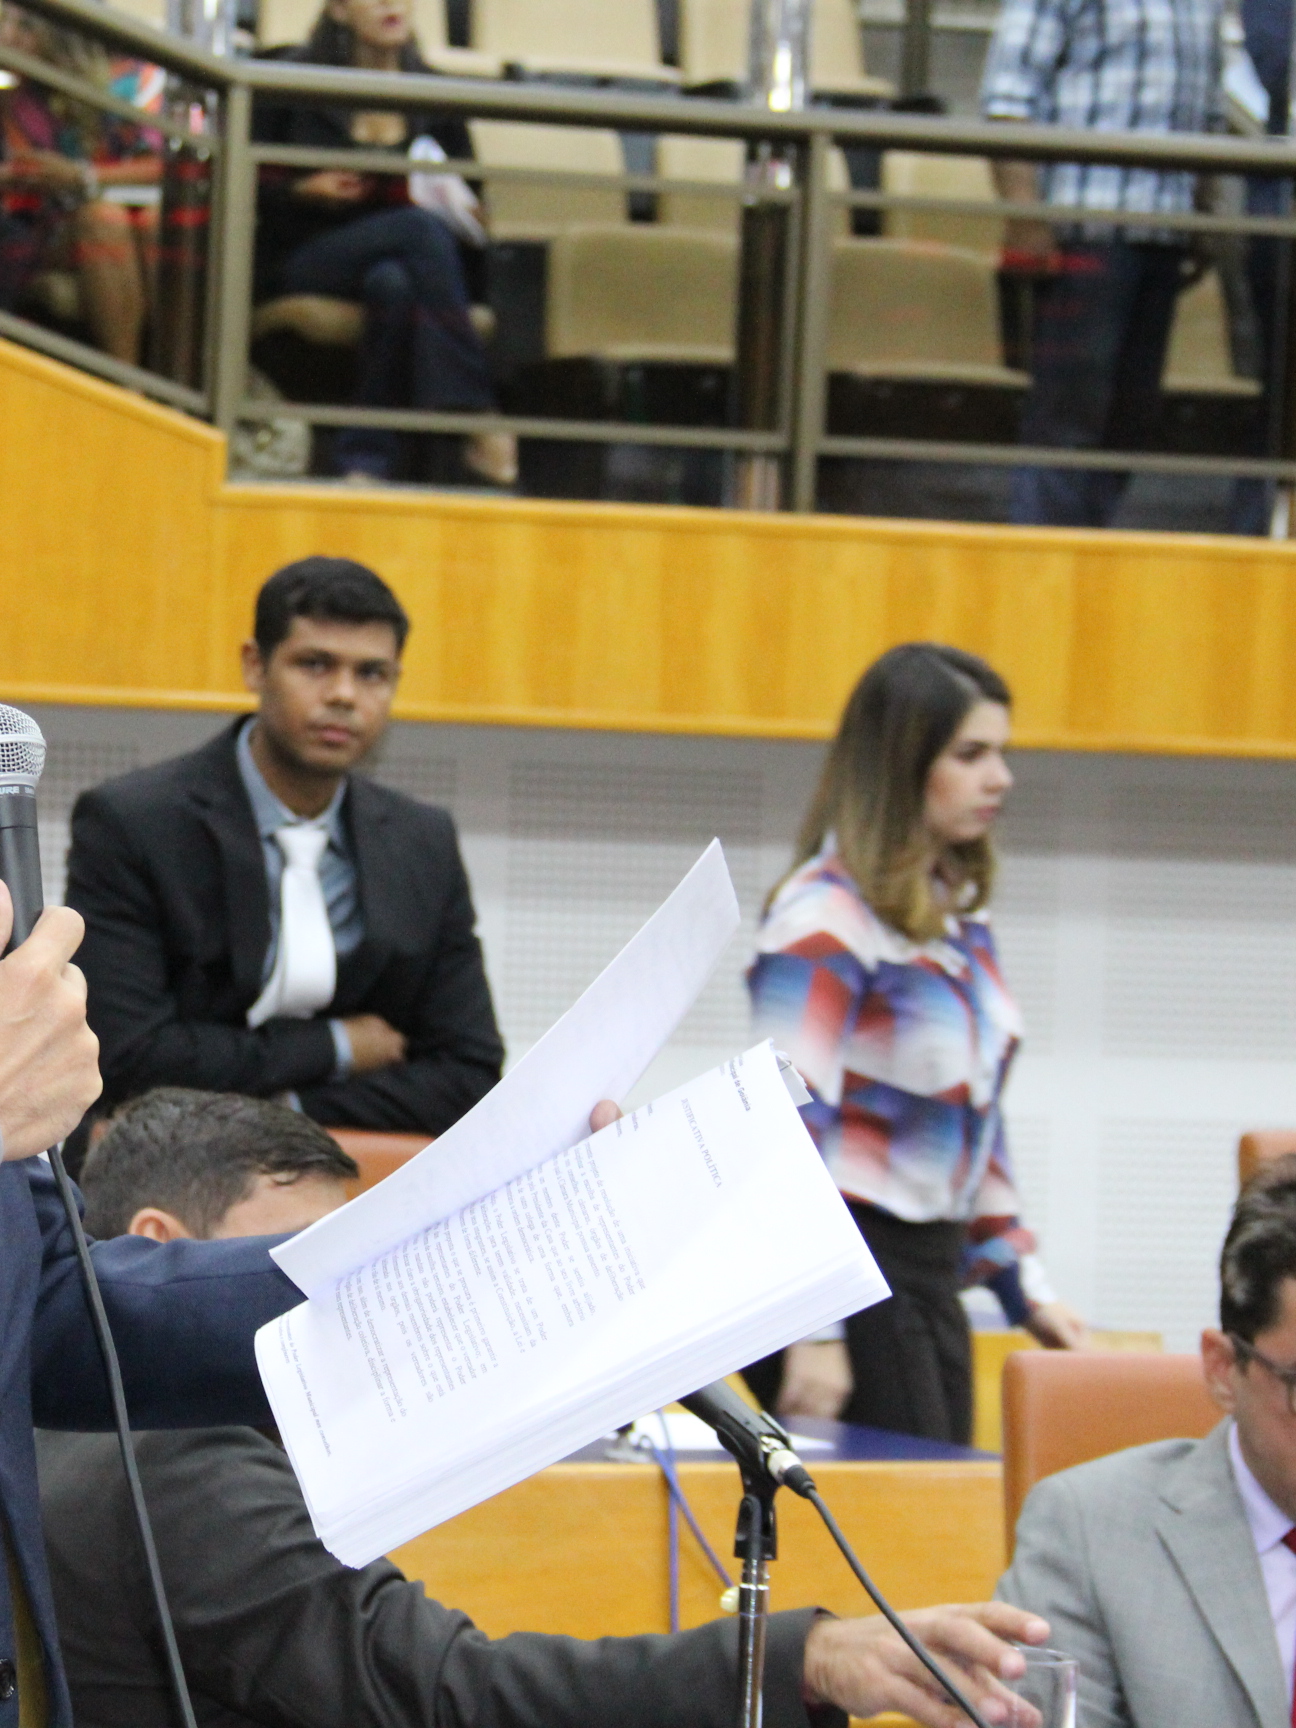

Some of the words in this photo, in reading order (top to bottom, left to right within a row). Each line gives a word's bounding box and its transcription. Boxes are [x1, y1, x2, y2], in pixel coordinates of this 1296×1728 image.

[681, 1098, 705, 1149] JUSTIFICATIVA
[701, 1149, 722, 1188] POLÍTICA
[737, 1087, 751, 1111] Goiânia
[468, 1250, 481, 1276] diferente.
[511, 1209, 521, 1226] ordem
[517, 1226, 534, 1264] democrática.
[525, 1213, 535, 1231] colega
[532, 1233, 539, 1241] de
[537, 1246, 546, 1259] uma
[544, 1261, 555, 1282] forma
[553, 1285, 562, 1300] que,
[561, 1303, 574, 1327] embora
[540, 1220, 547, 1228] da
[544, 1228, 553, 1244] Casa
[549, 1246, 559, 1257] que
[556, 1259, 563, 1267] ao
[560, 1268, 568, 1280] seu
[565, 1280, 575, 1296] livre
[572, 1298, 585, 1321] arbítrio
[550, 1212, 560, 1228] deste
[558, 1231, 570, 1250] Poder
[568, 1255, 574, 1263] se
[573, 1267, 584, 1287] sentiu
[583, 1291, 595, 1315] alijado,
[559, 1179, 569, 1200] Câmara
[566, 1199, 581, 1230] Municipal
[576, 1230, 589, 1253] possua
[586, 1254, 600, 1277] assento.
[577, 1198, 591, 1225] câmaras,
[589, 1228, 601, 1249] órgãos
[600, 1253, 607, 1261] de
[605, 1265, 623, 1301] deliberação
[583, 1179, 595, 1200] escolha
[592, 1204, 599, 1212] de
[598, 1215, 619, 1260] representantes
[618, 1264, 625, 1272] do
[623, 1275, 635, 1295] Poder
[596, 1179, 603, 1187] de
[601, 1188, 615, 1217] resolução
[617, 1232, 626, 1244] uma
[624, 1246, 640, 1276] iniciativa
[636, 1278, 646, 1290] que
[448, 1282, 455, 1291] do
[453, 1294, 464, 1314] Poder
[462, 1318, 481, 1358] Legislativo;
[480, 1363, 487, 1373] em
[452, 1257, 460, 1268] que
[458, 1276, 471, 1300] procura
[469, 1307, 485, 1335] primeiro
[481, 1338, 496, 1361] garantir
[486, 1265, 496, 1282] assim
[495, 1287, 515, 1331] Constituição,
[515, 1335, 523, 1347] Lei
[488, 1234, 497, 1248] para
[494, 1249, 504, 1267] terem
[502, 1269, 516, 1298] validade,
[514, 1301, 532, 1336] necessitam
[529, 1339, 536, 1348] da
[500, 1230, 516, 1264] Legislativo
[513, 1267, 520, 1275] se
[518, 1277, 527, 1293] trata
[525, 1296, 532, 1305] de
[530, 1310, 538, 1319] um
[536, 1321, 547, 1340] Poder
[348, 1299, 362, 1329] deliberação
[358, 1331, 370, 1357] coletiva,
[367, 1357, 383, 1390] disciplinar
[382, 1396, 393, 1417] forma
[366, 1318, 384, 1356] democratizar
[382, 1363, 403, 1407] representação
[399, 1408, 407, 1417] do
[396, 1320, 407, 1335] pois
[405, 1339, 412, 1347] os
[410, 1351, 427, 1387] vereadores
[425, 1391, 433, 1402] são
[401, 1291, 411, 1311] demais
[409, 1312, 422, 1342] membros
[419, 1343, 430, 1361] sobre
[430, 1371, 438, 1382] que
[435, 1384, 445, 1397] está
[413, 1286, 432, 1332] obrigatoriedade
[429, 1333, 437, 1345] dos
[435, 1345, 455, 1391] representantes
[425, 1292, 437, 1313] poderá
[435, 1316, 453, 1351] representar
[455, 1365, 466, 1384] Poder
[441, 1297, 458, 1331] estabelecer
[454, 1333, 463, 1345] que
[463, 1353, 477, 1379] vereador
[296, 1363, 307, 1390] Legislativo
[306, 1391, 318, 1417] Municipal
[320, 1430, 331, 1456] conselhos,
